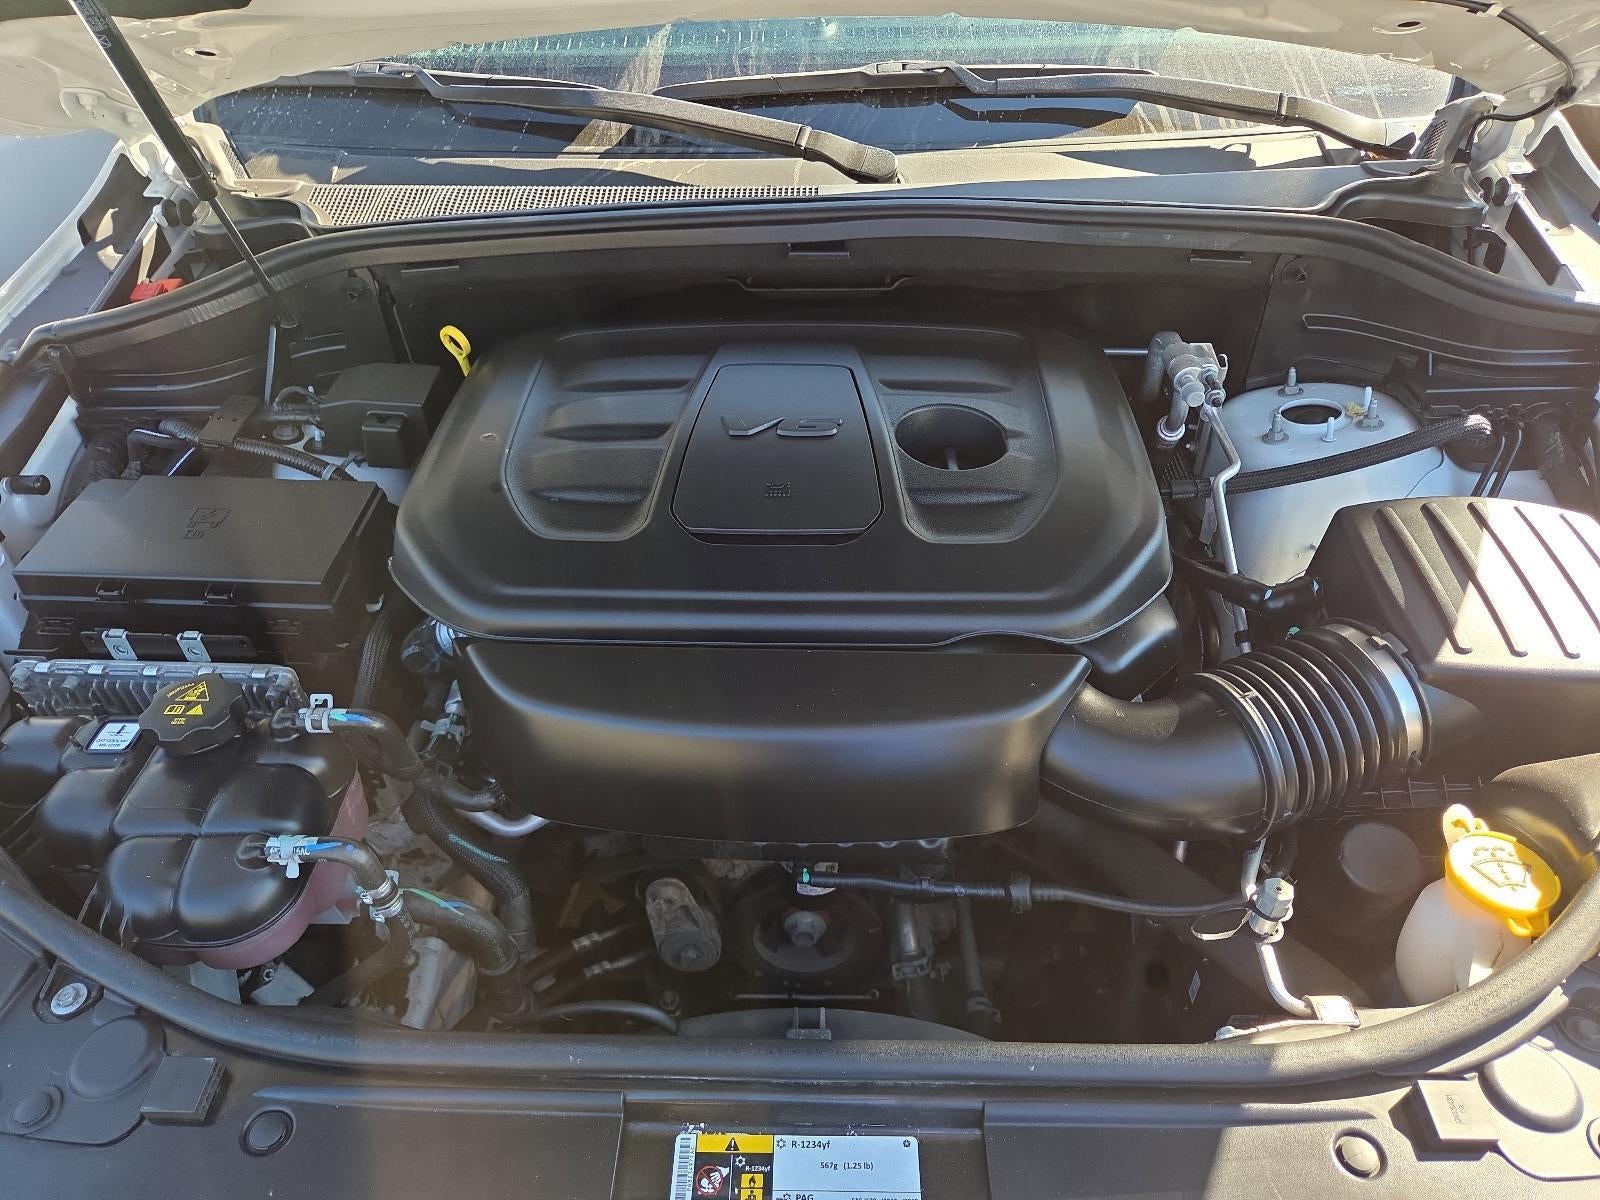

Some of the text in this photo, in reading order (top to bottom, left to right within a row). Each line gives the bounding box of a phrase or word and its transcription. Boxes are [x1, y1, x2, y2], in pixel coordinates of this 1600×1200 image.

[719, 415, 844, 437] V6
[791, 1140, 831, 1150] R-1234yf
[820, 1161, 874, 1171] 567g (1.25 lb)
